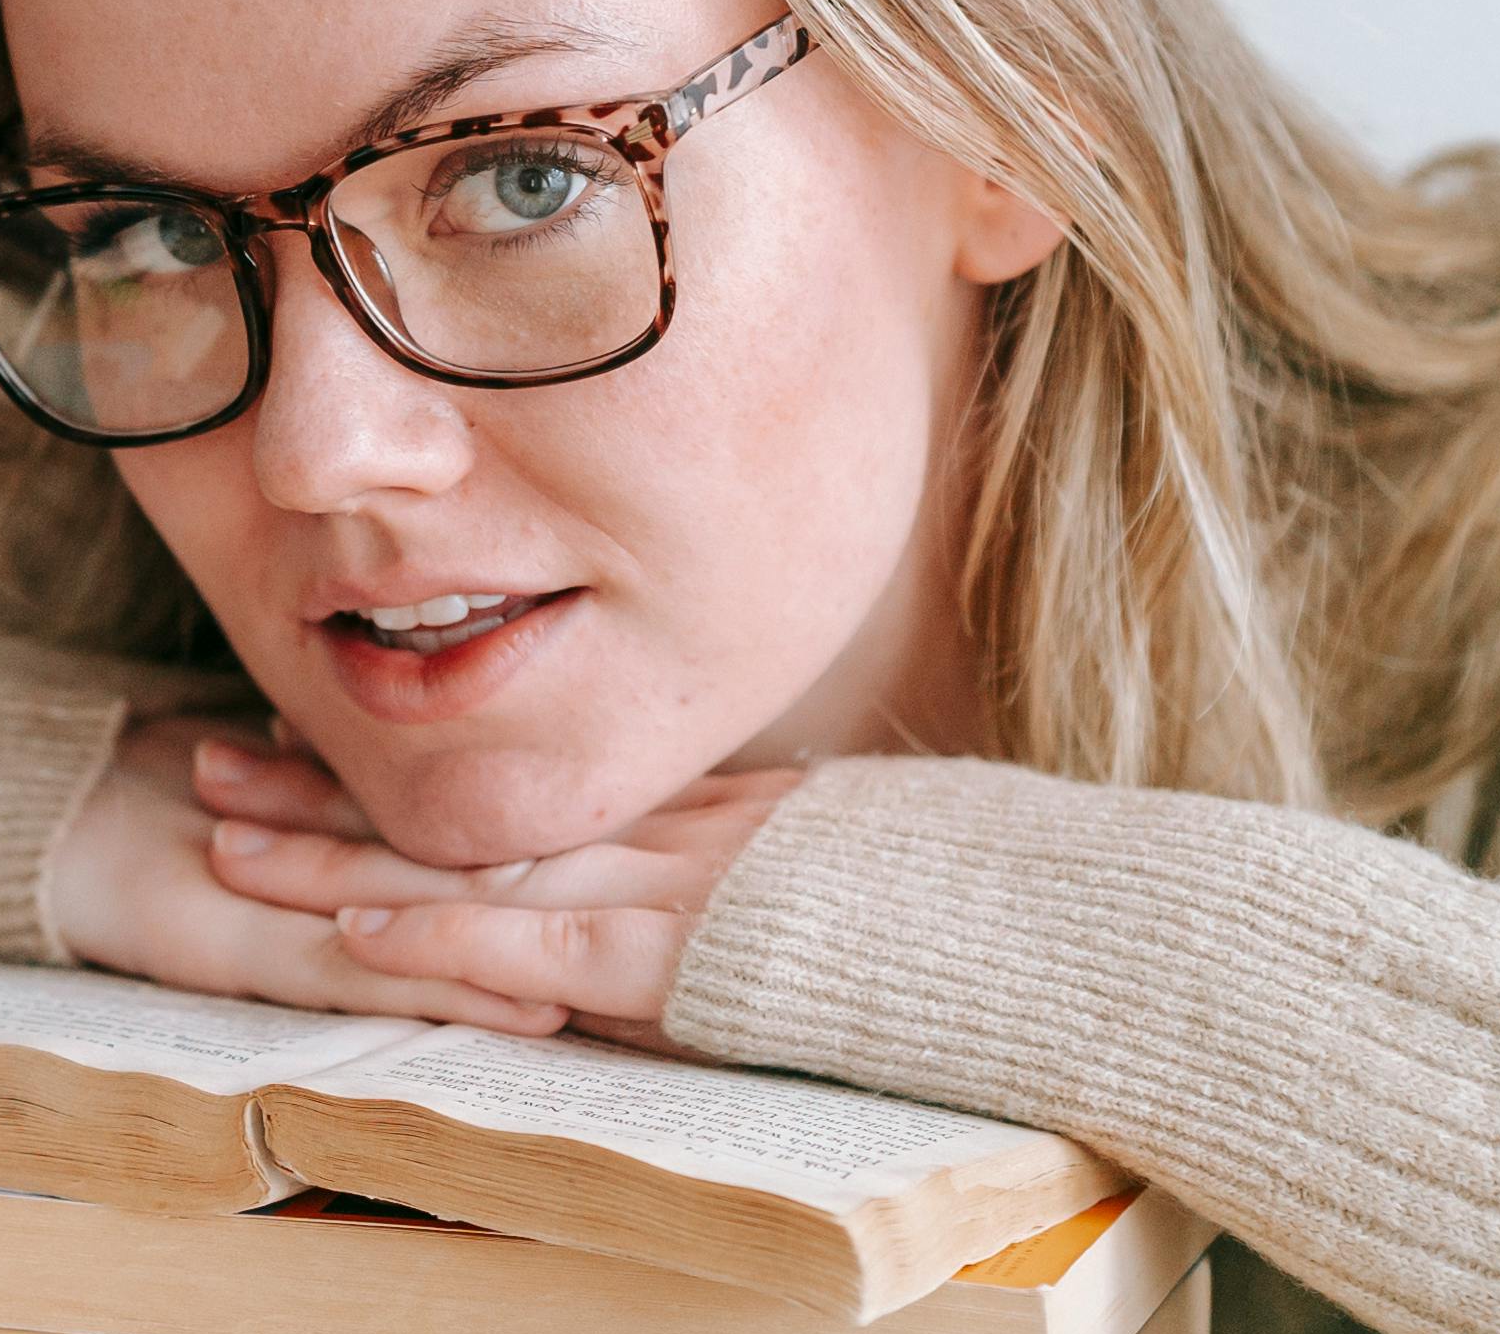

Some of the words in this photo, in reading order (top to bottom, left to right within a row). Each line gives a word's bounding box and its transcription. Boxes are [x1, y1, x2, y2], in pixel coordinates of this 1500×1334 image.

[431, 1075, 513, 1092] caressing
[574, 1109, 675, 1133] narrowing.
[798, 1160, 851, 1179] Look
